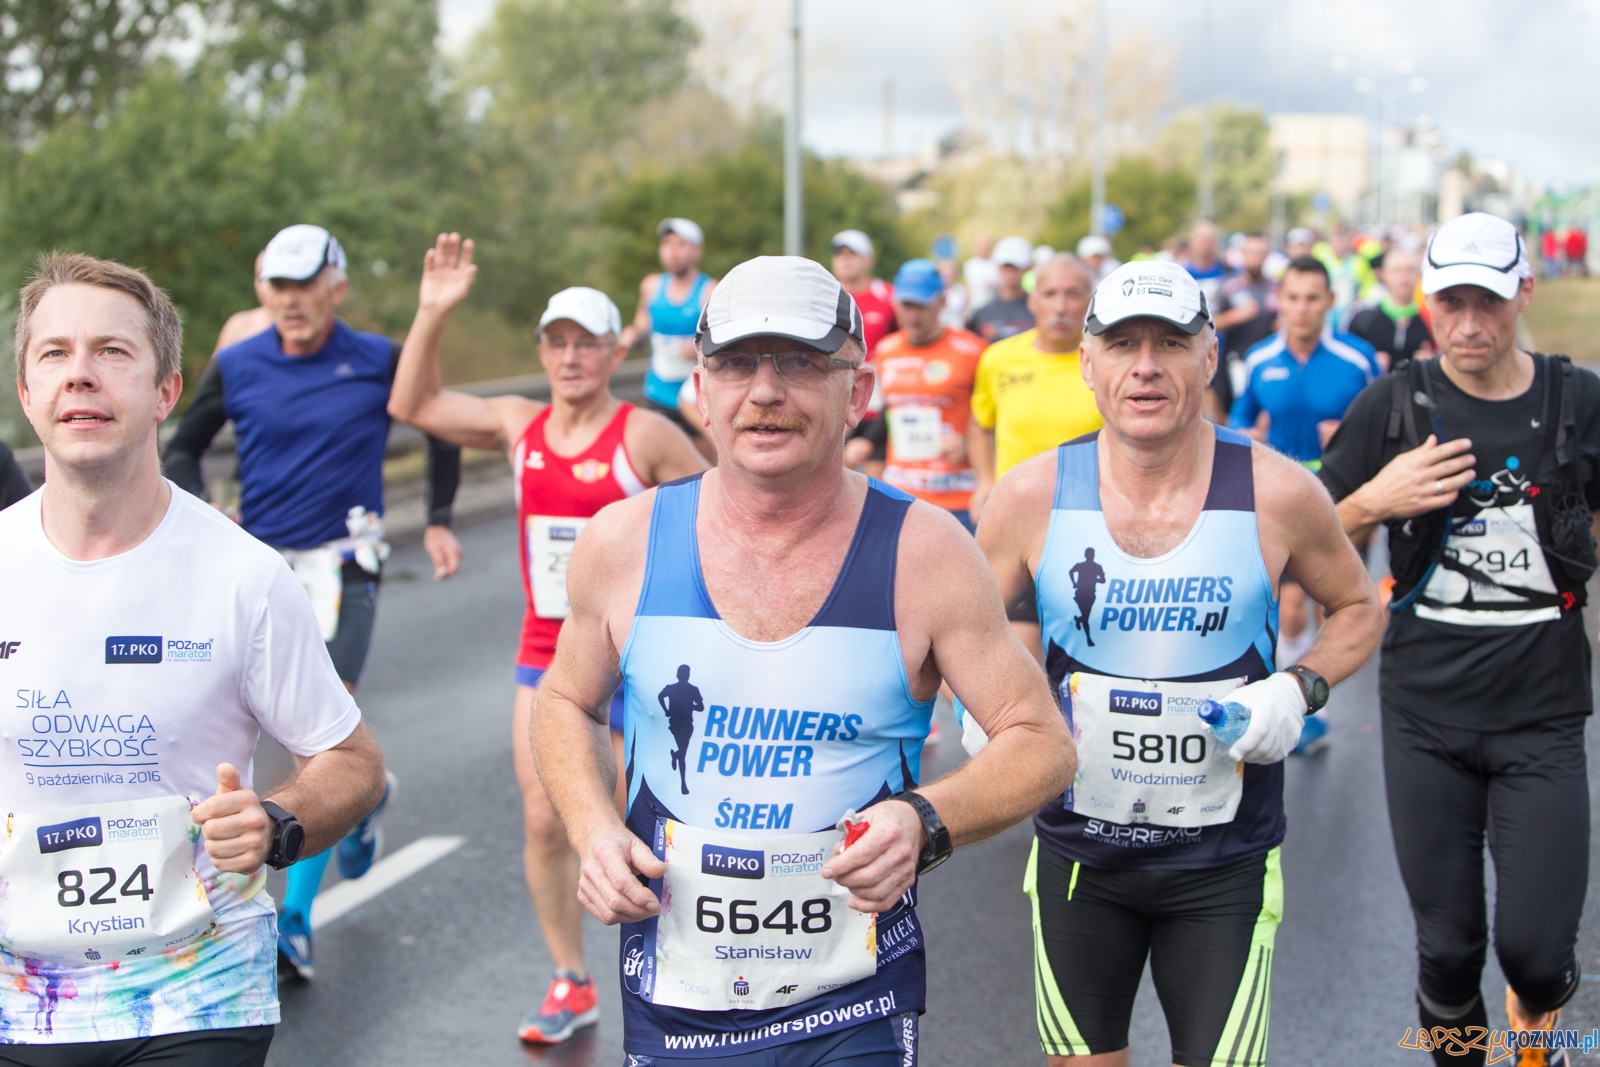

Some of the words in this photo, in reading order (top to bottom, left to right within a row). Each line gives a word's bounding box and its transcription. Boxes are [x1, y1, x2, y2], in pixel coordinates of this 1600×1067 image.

[1105, 576, 1233, 604] RUNNER'S
[1100, 606, 1229, 637] POWER.pl
[111, 644, 128, 656] 17.
[130, 644, 158, 656] PKO
[168, 650, 211, 658] maraton
[16, 689, 72, 709] SIŁA
[1113, 696, 1131, 708] 17.
[1131, 698, 1159, 711] PKO
[1167, 704, 1198, 713] marat
[32, 715, 156, 733] ODWAGA
[704, 705, 863, 742] RUNNER'S
[18, 735, 158, 757] SZYBKOŚĆ
[1113, 730, 1206, 764] 5810
[697, 742, 813, 777] POWER
[26, 772, 35, 785] 9
[37, 774, 124, 787] października
[128, 771, 161, 784] 2016
[1111, 767, 1207, 786] Włodzimierz
[715, 797, 794, 829] ŚREM
[1167, 806, 1185, 815] 4F
[43, 832, 64, 845] 17.
[66, 825, 98, 841] PKO
[108, 827, 159, 839] maraton
[1084, 819, 1203, 843] SUPREMO
[1083, 832, 1129, 848] INNOWACJE
[1132, 835, 1203, 849] INFORMATYCZNE
[707, 853, 726, 868] 17.
[727, 856, 760, 871] PKO
[771, 862, 823, 874] maraton
[57, 863, 155, 908] 824
[696, 895, 832, 935] 6648
[68, 915, 146, 936] Krystian
[907, 936, 918, 947] 39
[126, 947, 147, 955] 4F
[715, 945, 813, 960] Stanisław
[775, 984, 799, 994] 4F
[664, 990, 898, 1050] www.runnerspower.pl
